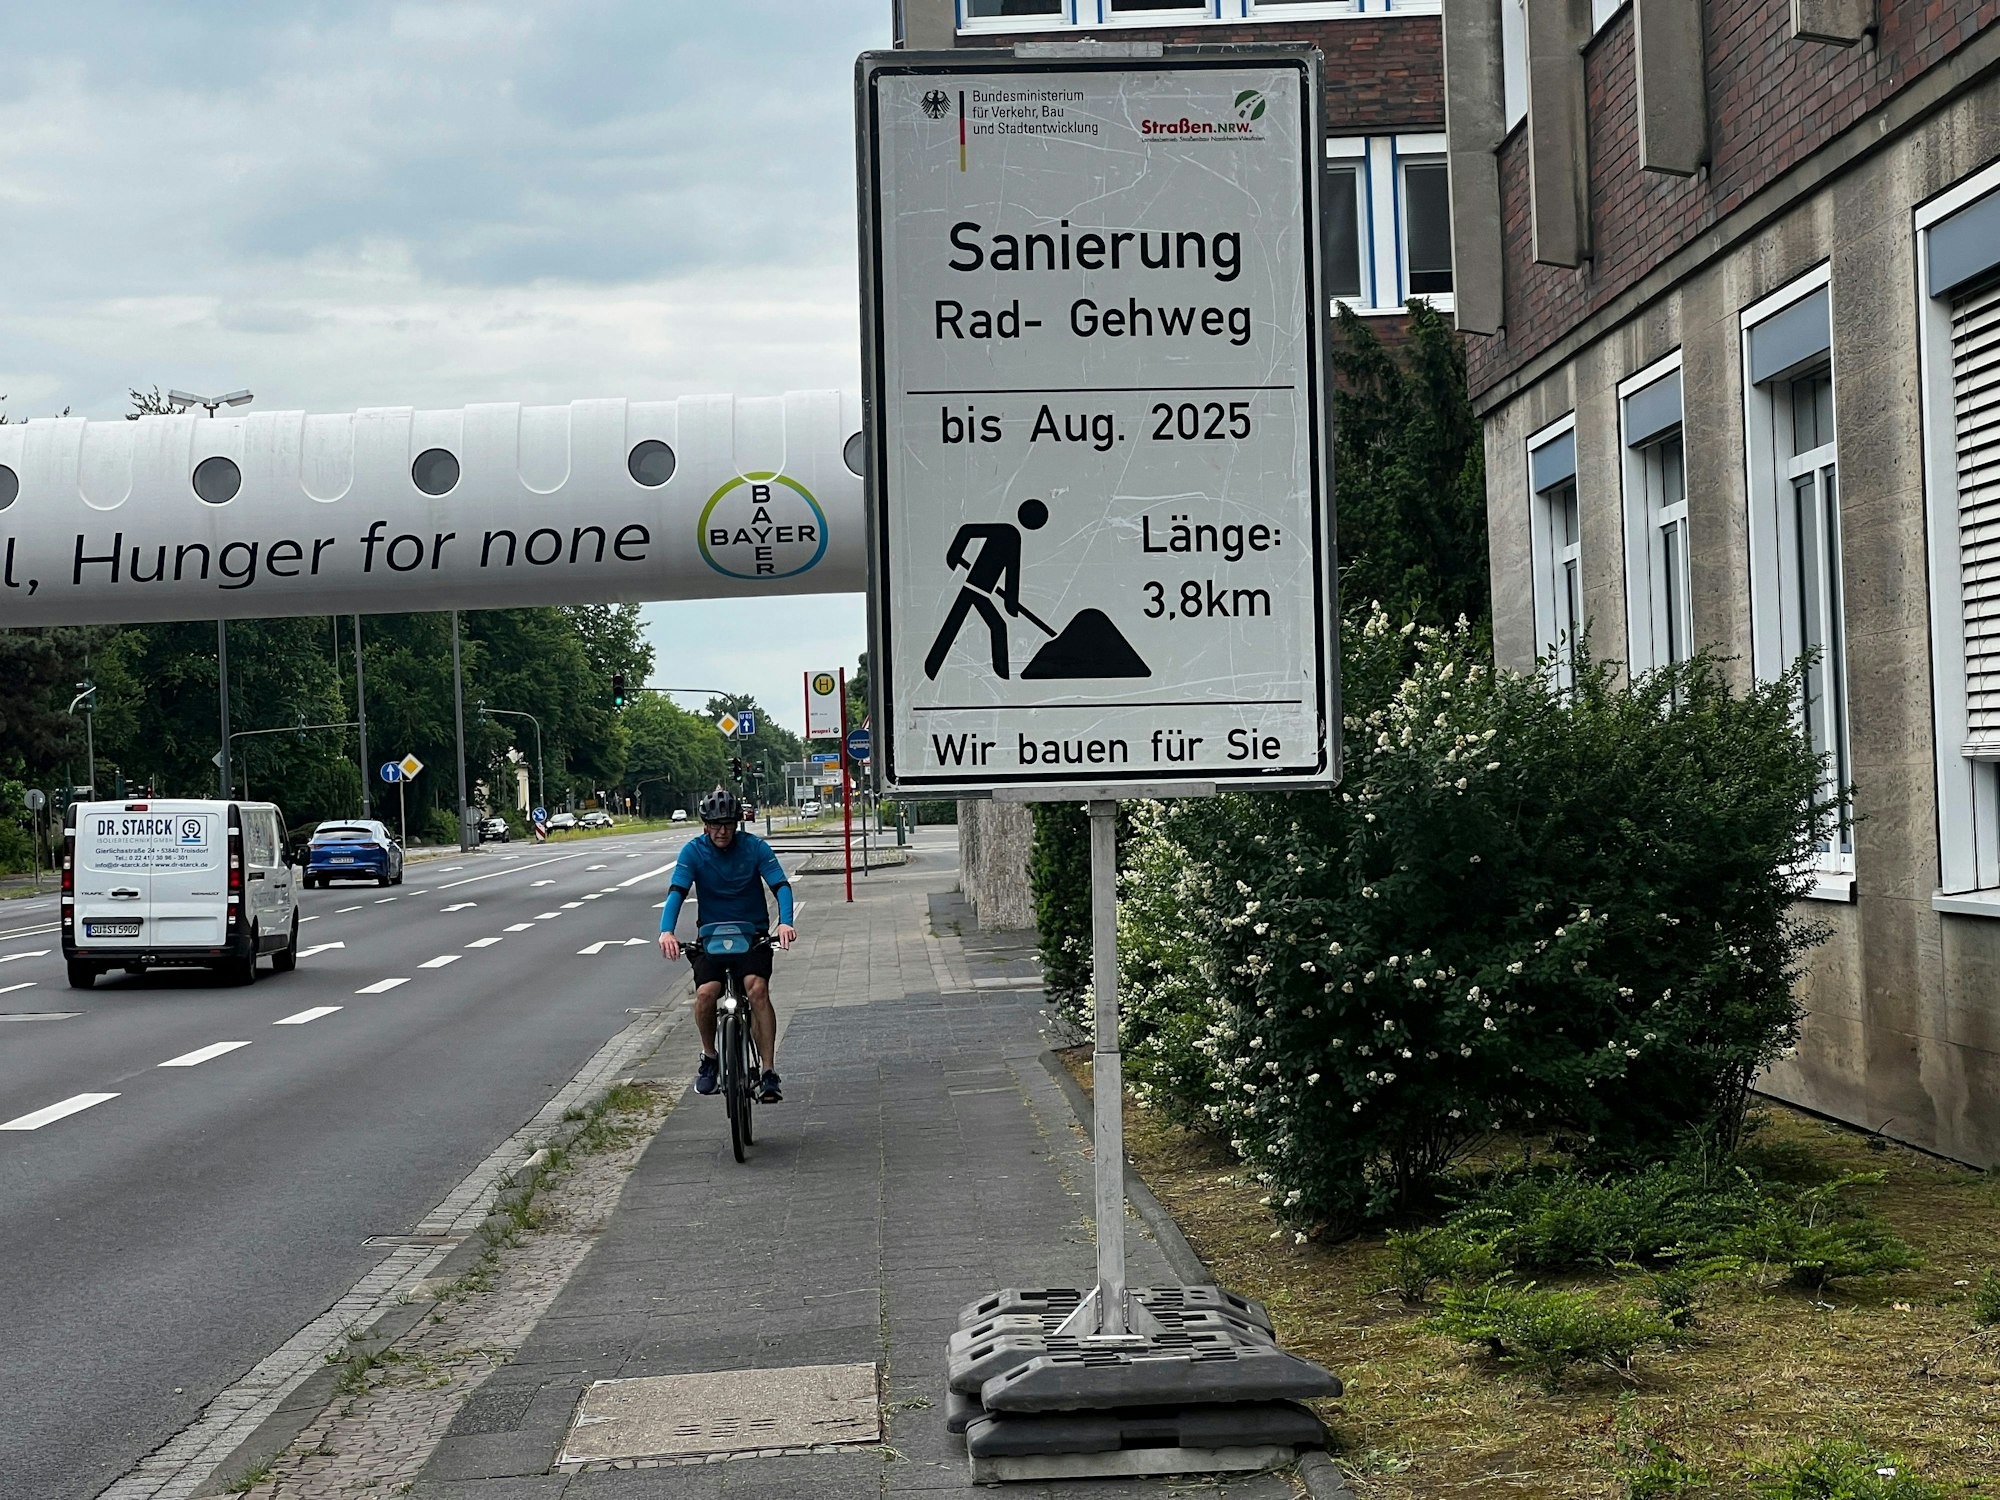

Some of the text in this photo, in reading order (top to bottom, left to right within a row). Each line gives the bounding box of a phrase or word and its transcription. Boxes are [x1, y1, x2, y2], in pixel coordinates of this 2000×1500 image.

[972, 105, 1064, 119] für Verkehr, Bau
[973, 89, 1084, 102] Bundesministerium
[973, 121, 1099, 135] und Stadtentwicklung
[948, 220, 1242, 282] Sanierung
[935, 297, 1252, 346] Rad- Gehweg
[941, 402, 1252, 452] bis Aug. 2025
[710, 525, 817, 546] BAYER
[751, 484, 776, 575] BAYER
[1141, 514, 1282, 562] Länge:
[72, 532, 336, 590] Hunger
[360, 520, 456, 573] for
[480, 524, 651, 568] none
[1142, 579, 1272, 621] 3,8km
[819, 678, 829, 691] H
[931, 727, 1281, 767] Wir bauen für Sie
[98, 819, 173, 835] DR. STARCK
[92, 925, 102, 934] SU
[107, 925, 118, 934] ST
